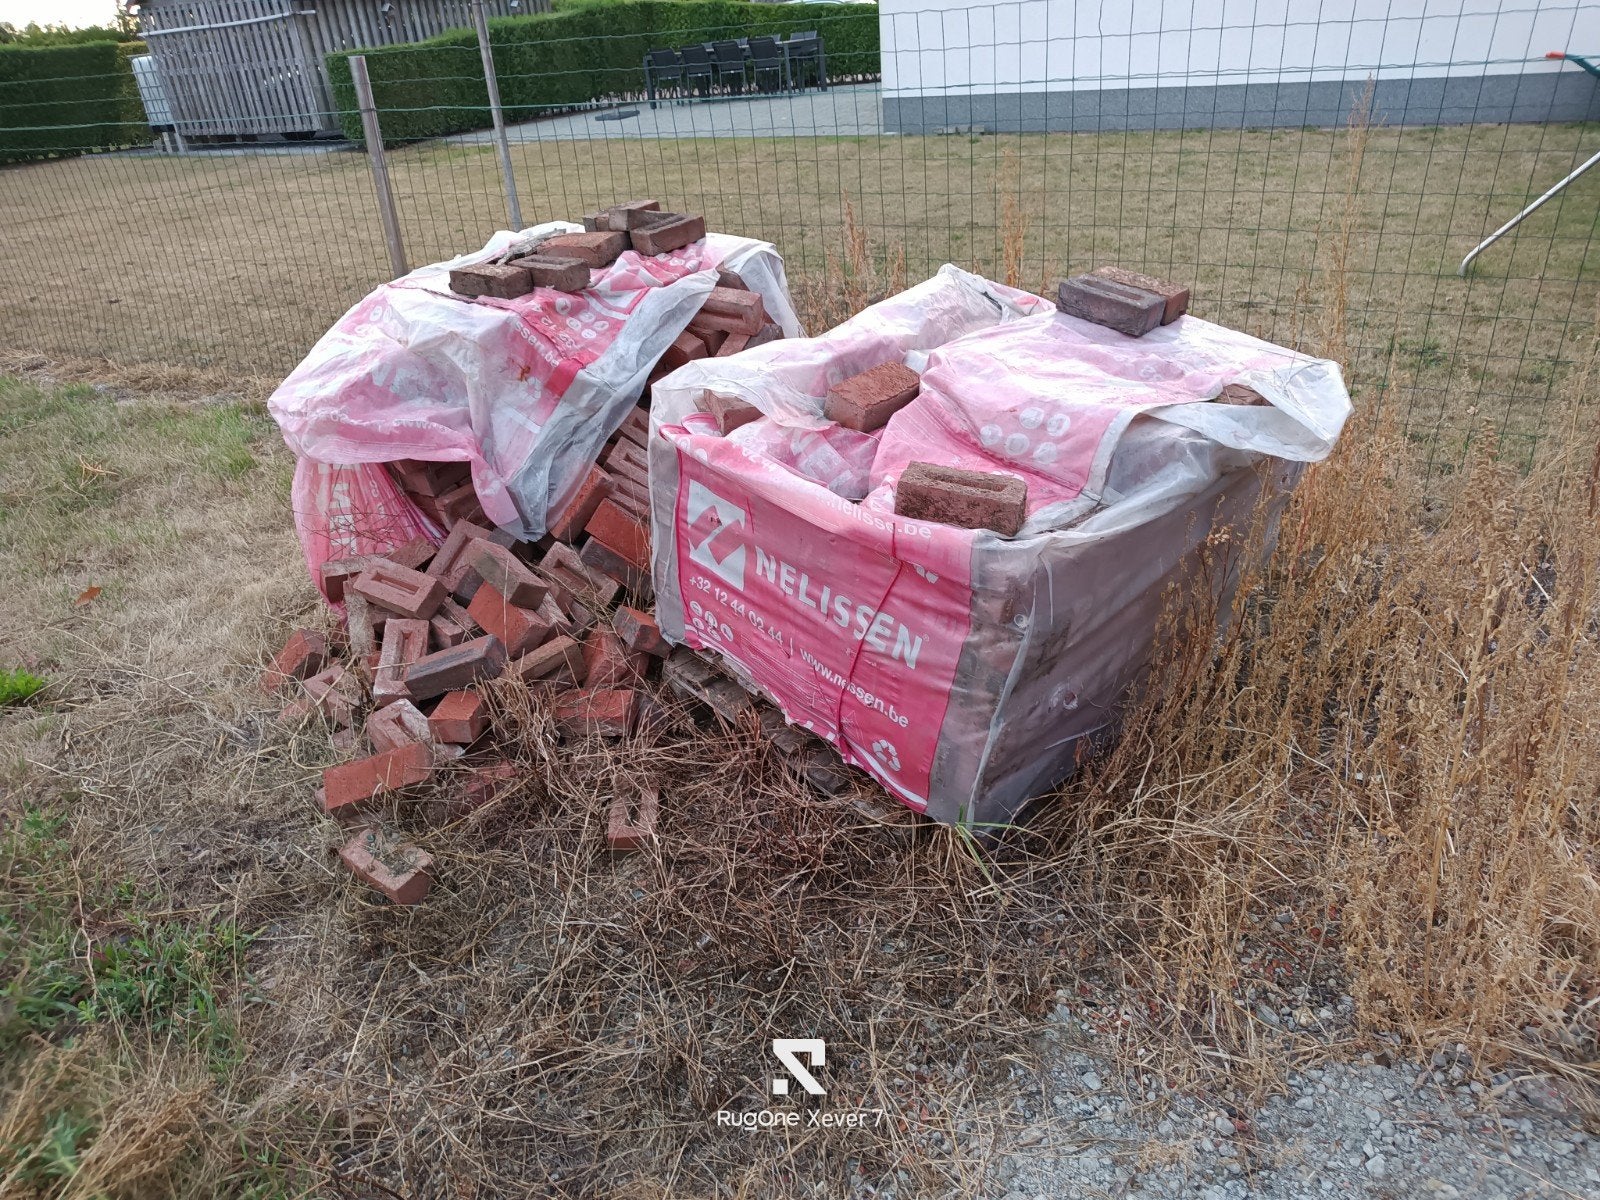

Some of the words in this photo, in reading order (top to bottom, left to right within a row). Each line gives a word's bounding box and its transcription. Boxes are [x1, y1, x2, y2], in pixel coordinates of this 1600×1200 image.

[689, 576, 711, 593] +32
[714, 588, 728, 606] 12
[730, 600, 745, 616] 44
[748, 611, 764, 631] 02
[767, 626, 784, 645] 44
[755, 546, 923, 670] NELISSEN
